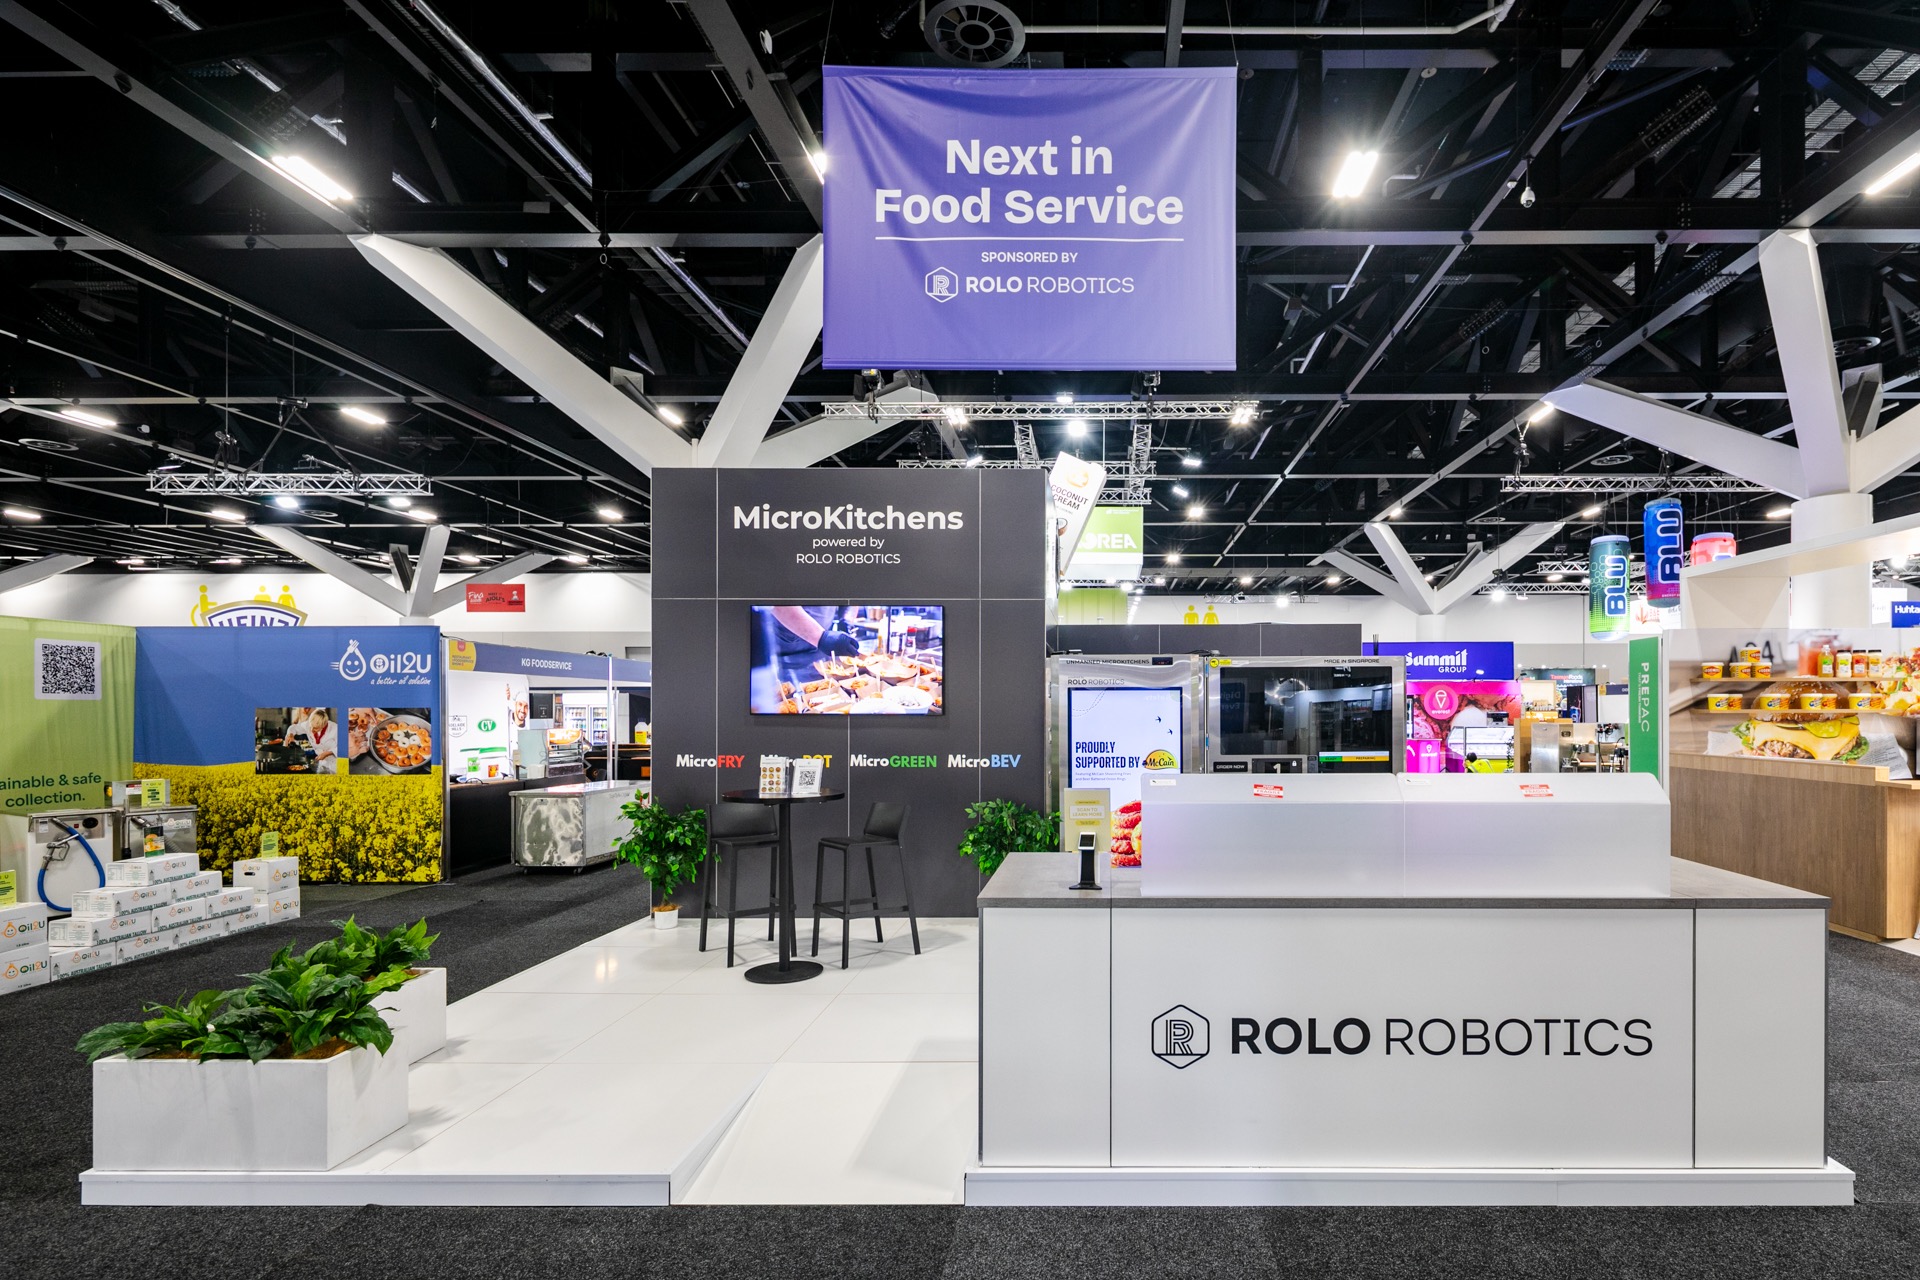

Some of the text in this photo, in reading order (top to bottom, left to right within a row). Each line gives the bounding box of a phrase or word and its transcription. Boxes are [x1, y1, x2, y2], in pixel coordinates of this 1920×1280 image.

[946, 135, 1113, 176] Next in
[875, 185, 1184, 226] Food Service
[981, 251, 1079, 264] SPONSORED BY
[966, 276, 1135, 294] ROLO ROBOTICS
[1051, 484, 1088, 505] COCONUT
[1053, 494, 1080, 511] CREAM
[733, 503, 964, 530] MicroKitchens
[812, 537, 885, 549] powered by
[796, 553, 901, 564] ROLO ROBOTICS
[369, 651, 432, 674] Oil2U
[521, 657, 573, 671] KG FOODSERVICE
[1405, 649, 1468, 666] Summit
[376, 675, 397, 685] better
[398, 675, 409, 685] oil
[408, 675, 431, 685] solution
[1641, 662, 1650, 733] PREPAC
[480, 720, 493, 731] CV
[1075, 742, 1116, 754] PROUDLY
[676, 754, 745, 768] MicroFRY
[850, 754, 937, 768] MicroGREEN
[948, 754, 1021, 768] MicroBEV
[1075, 756, 1140, 769] SUPPORTED BY
[1147, 757, 1175, 767] McCain
[58, 773, 70, 786] &
[72, 772, 102, 785] safe
[5, 791, 85, 808] collection.
[18, 920, 45, 932] Oil2U
[20, 960, 47, 973] Oil2U
[1230, 1016, 1654, 1056] ROLO ROBOTICS
